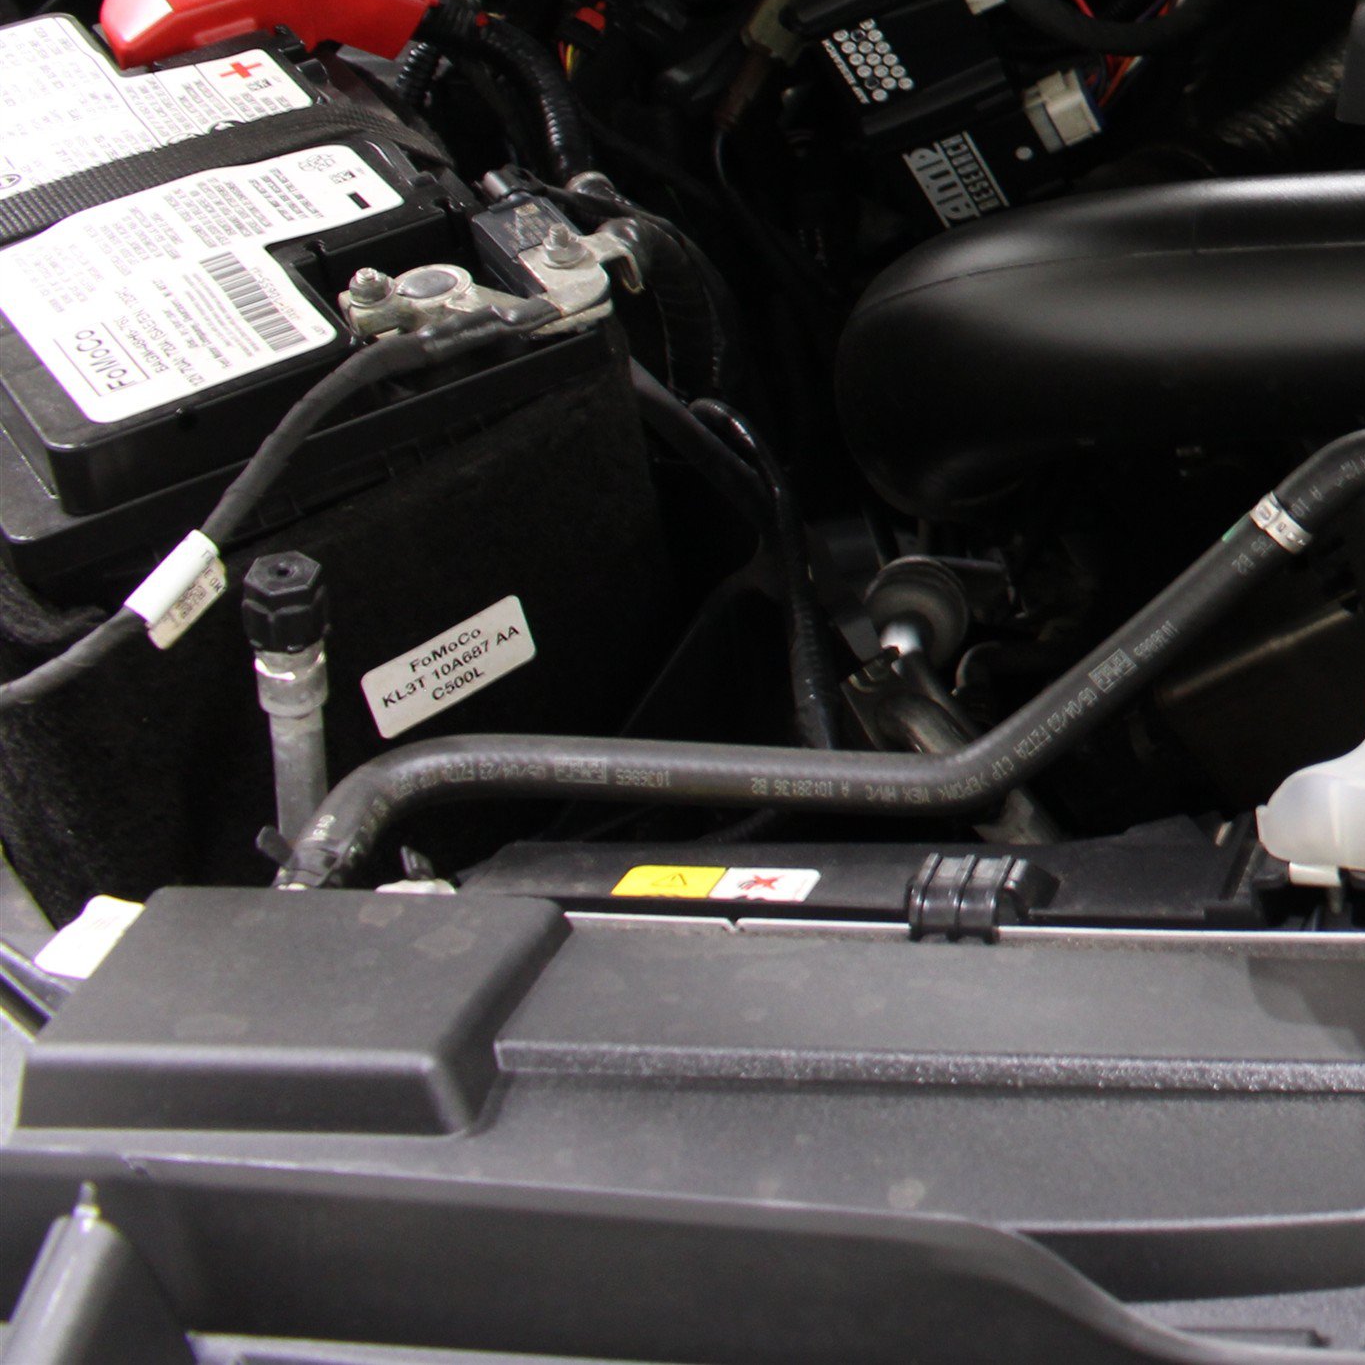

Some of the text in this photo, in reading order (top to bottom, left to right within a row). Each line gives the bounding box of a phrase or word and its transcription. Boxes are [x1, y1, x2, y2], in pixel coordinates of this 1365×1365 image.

[64, 325, 137, 392] FoMoCo
[381, 625, 520, 708] KL3T 10A687 AA
[409, 627, 482, 672] FoMoCo
[431, 667, 485, 701] C500L
[750, 777, 768, 796] B2
[841, 781, 850, 794] A
